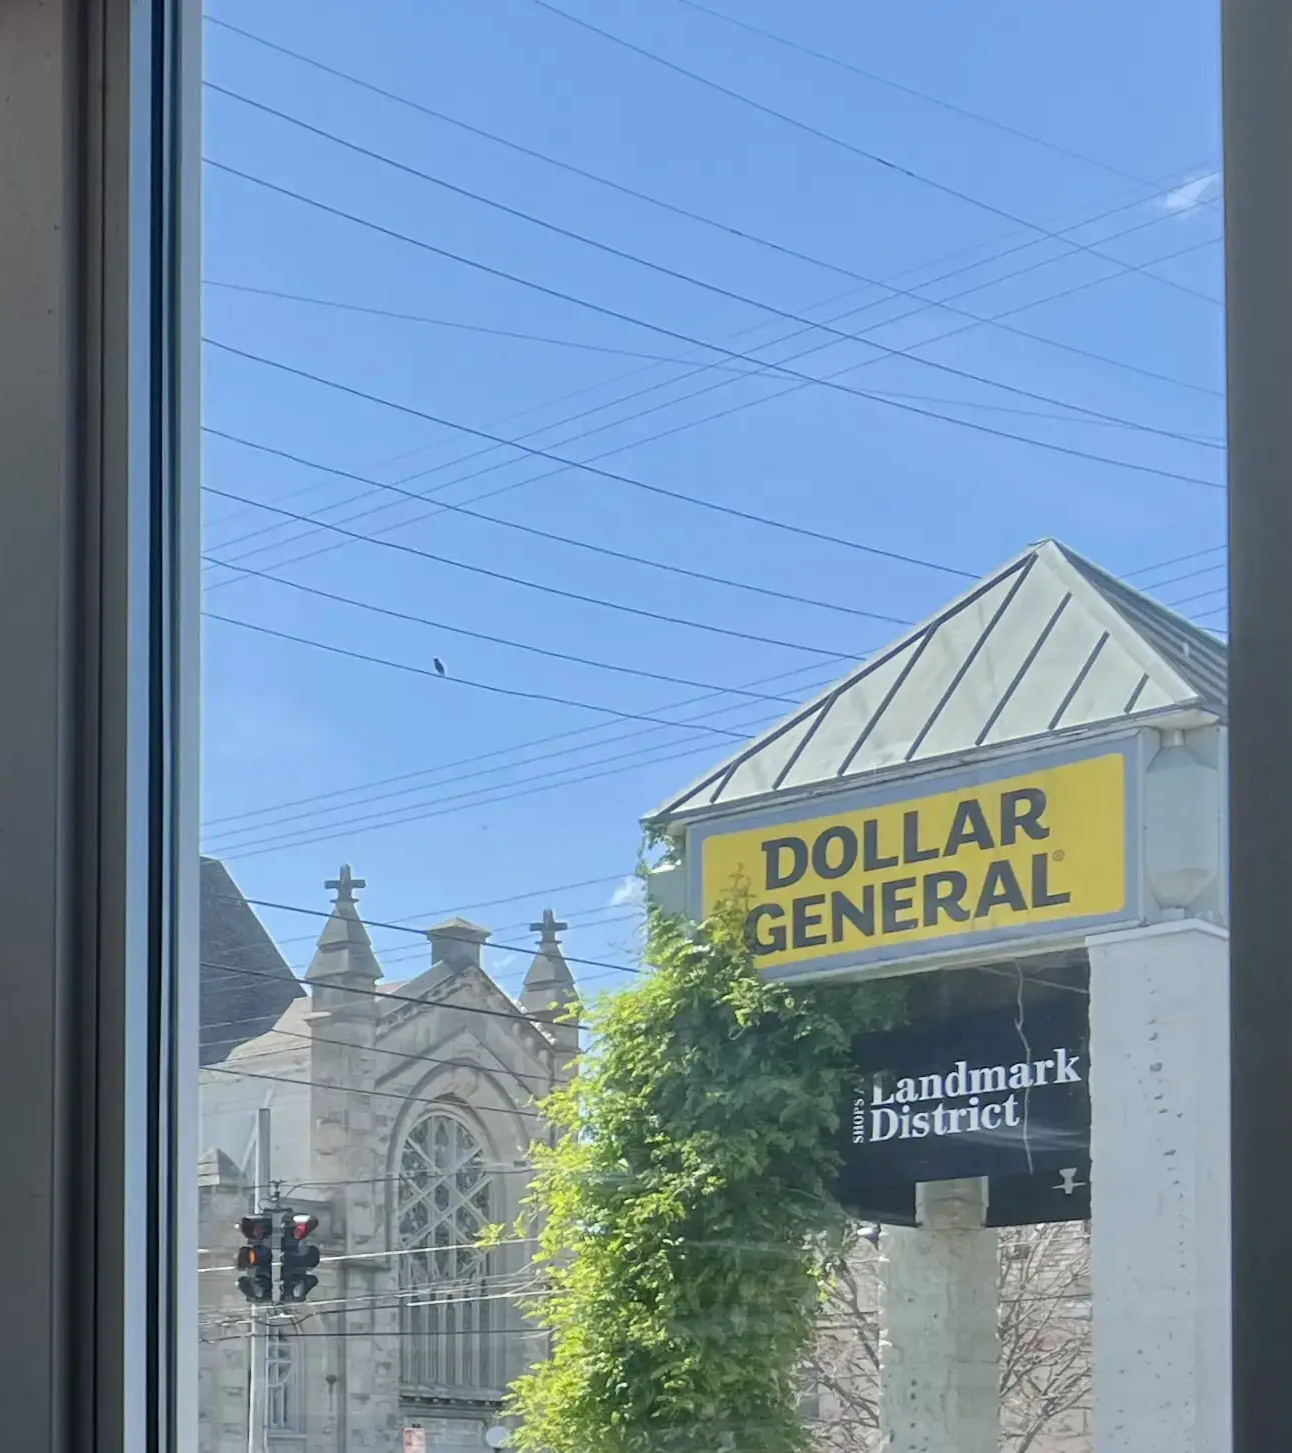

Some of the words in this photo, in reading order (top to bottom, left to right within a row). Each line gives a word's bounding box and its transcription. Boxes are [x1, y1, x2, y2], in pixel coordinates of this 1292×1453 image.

[761, 787, 1050, 891] DOLLAR
[743, 852, 1071, 957] GENERAL
[870, 1048, 1082, 1106] Landmark
[853, 1098, 865, 1144] SHOPS
[869, 1093, 1020, 1143] District
